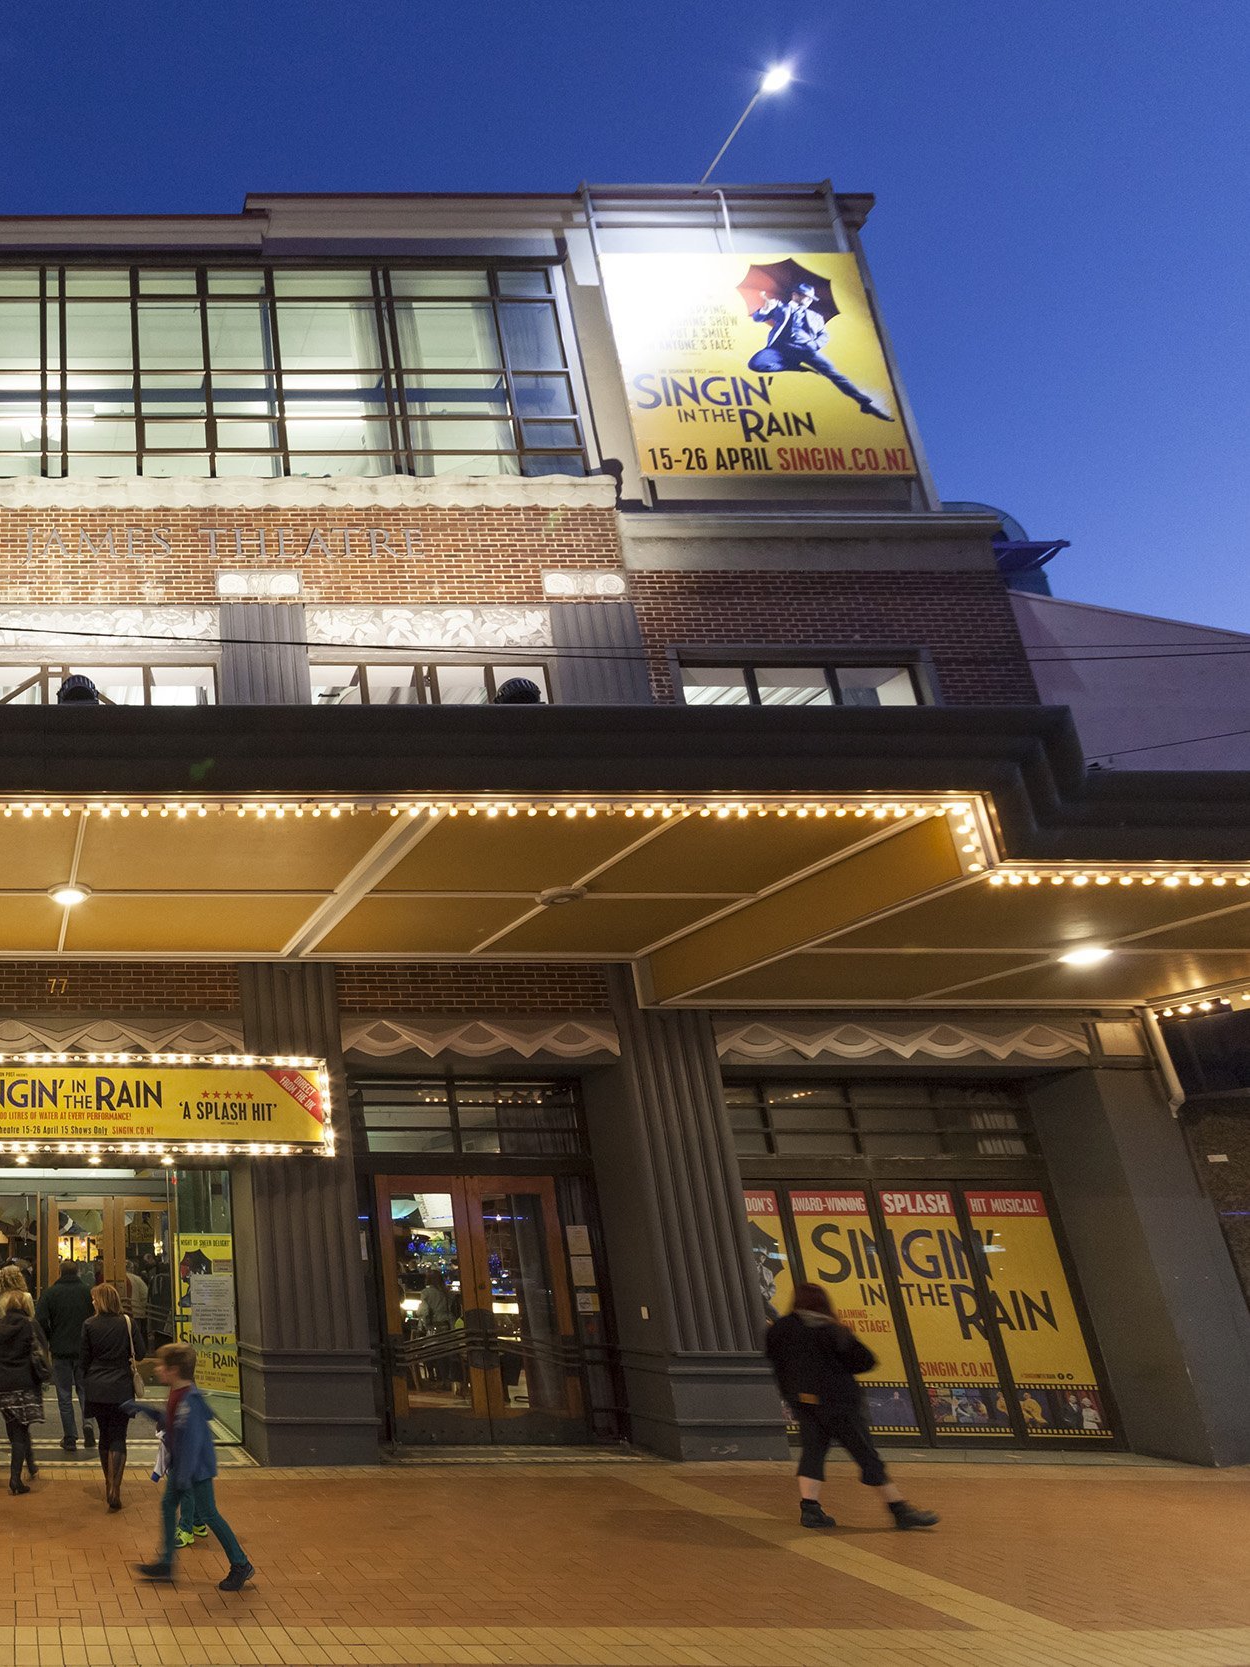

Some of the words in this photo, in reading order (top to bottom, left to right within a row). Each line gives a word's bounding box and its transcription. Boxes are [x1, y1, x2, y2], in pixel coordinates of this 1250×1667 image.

[677, 409, 697, 423] IN
[699, 409, 736, 423] THE
[738, 409, 816, 443] RAIN
[648, 448, 708, 471] 15-26
[716, 448, 773, 471] APRIL
[779, 448, 911, 472] SINGIN.CO.NZ
[21, 526, 172, 565] JAMES
[198, 526, 426, 559] THEATRE
[48, 978, 68, 994] 77
[63, 1095, 92, 1109] THE
[96, 1076, 162, 1111] RAIN
[72, 1080, 86, 1093] IN
[279, 1075, 298, 1094] FROM
[294, 1088, 309, 1104] THE
[304, 1099, 317, 1111] UK
[293, 1075, 317, 1096] DIRECT
[8, 1112, 28, 1120] LITRES
[30, 1112, 36, 1120] OF
[39, 1112, 58, 1120] WATER
[60, 1112, 67, 1120] AT
[68, 1112, 85, 1120] EVERY
[87, 1112, 131, 1120] PERFORMANCE!
[196, 1102, 247, 1121] SPLASH
[22, 1126, 41, 1134] 15-26
[43, 1126, 58, 1135] April
[61, 1126, 68, 1134] 15
[71, 1126, 91, 1134] Shows
[94, 1126, 108, 1135] Only
[112, 1126, 154, 1135] SINGIN.CO.NZ
[792, 1198, 866, 1212] AWARD-WINNING
[882, 1193, 951, 1214] SPLASH
[969, 1198, 987, 1213] HIT
[990, 1198, 1039, 1213] MUSICAL!
[860, 1284, 888, 1306] IN
[900, 1284, 950, 1307] THE
[950, 1284, 1060, 1340] RAIN
[857, 1320, 892, 1333] STAGE!
[213, 1352, 238, 1369] RAIN
[920, 1361, 996, 1377] SINGIN.CO.NZ
